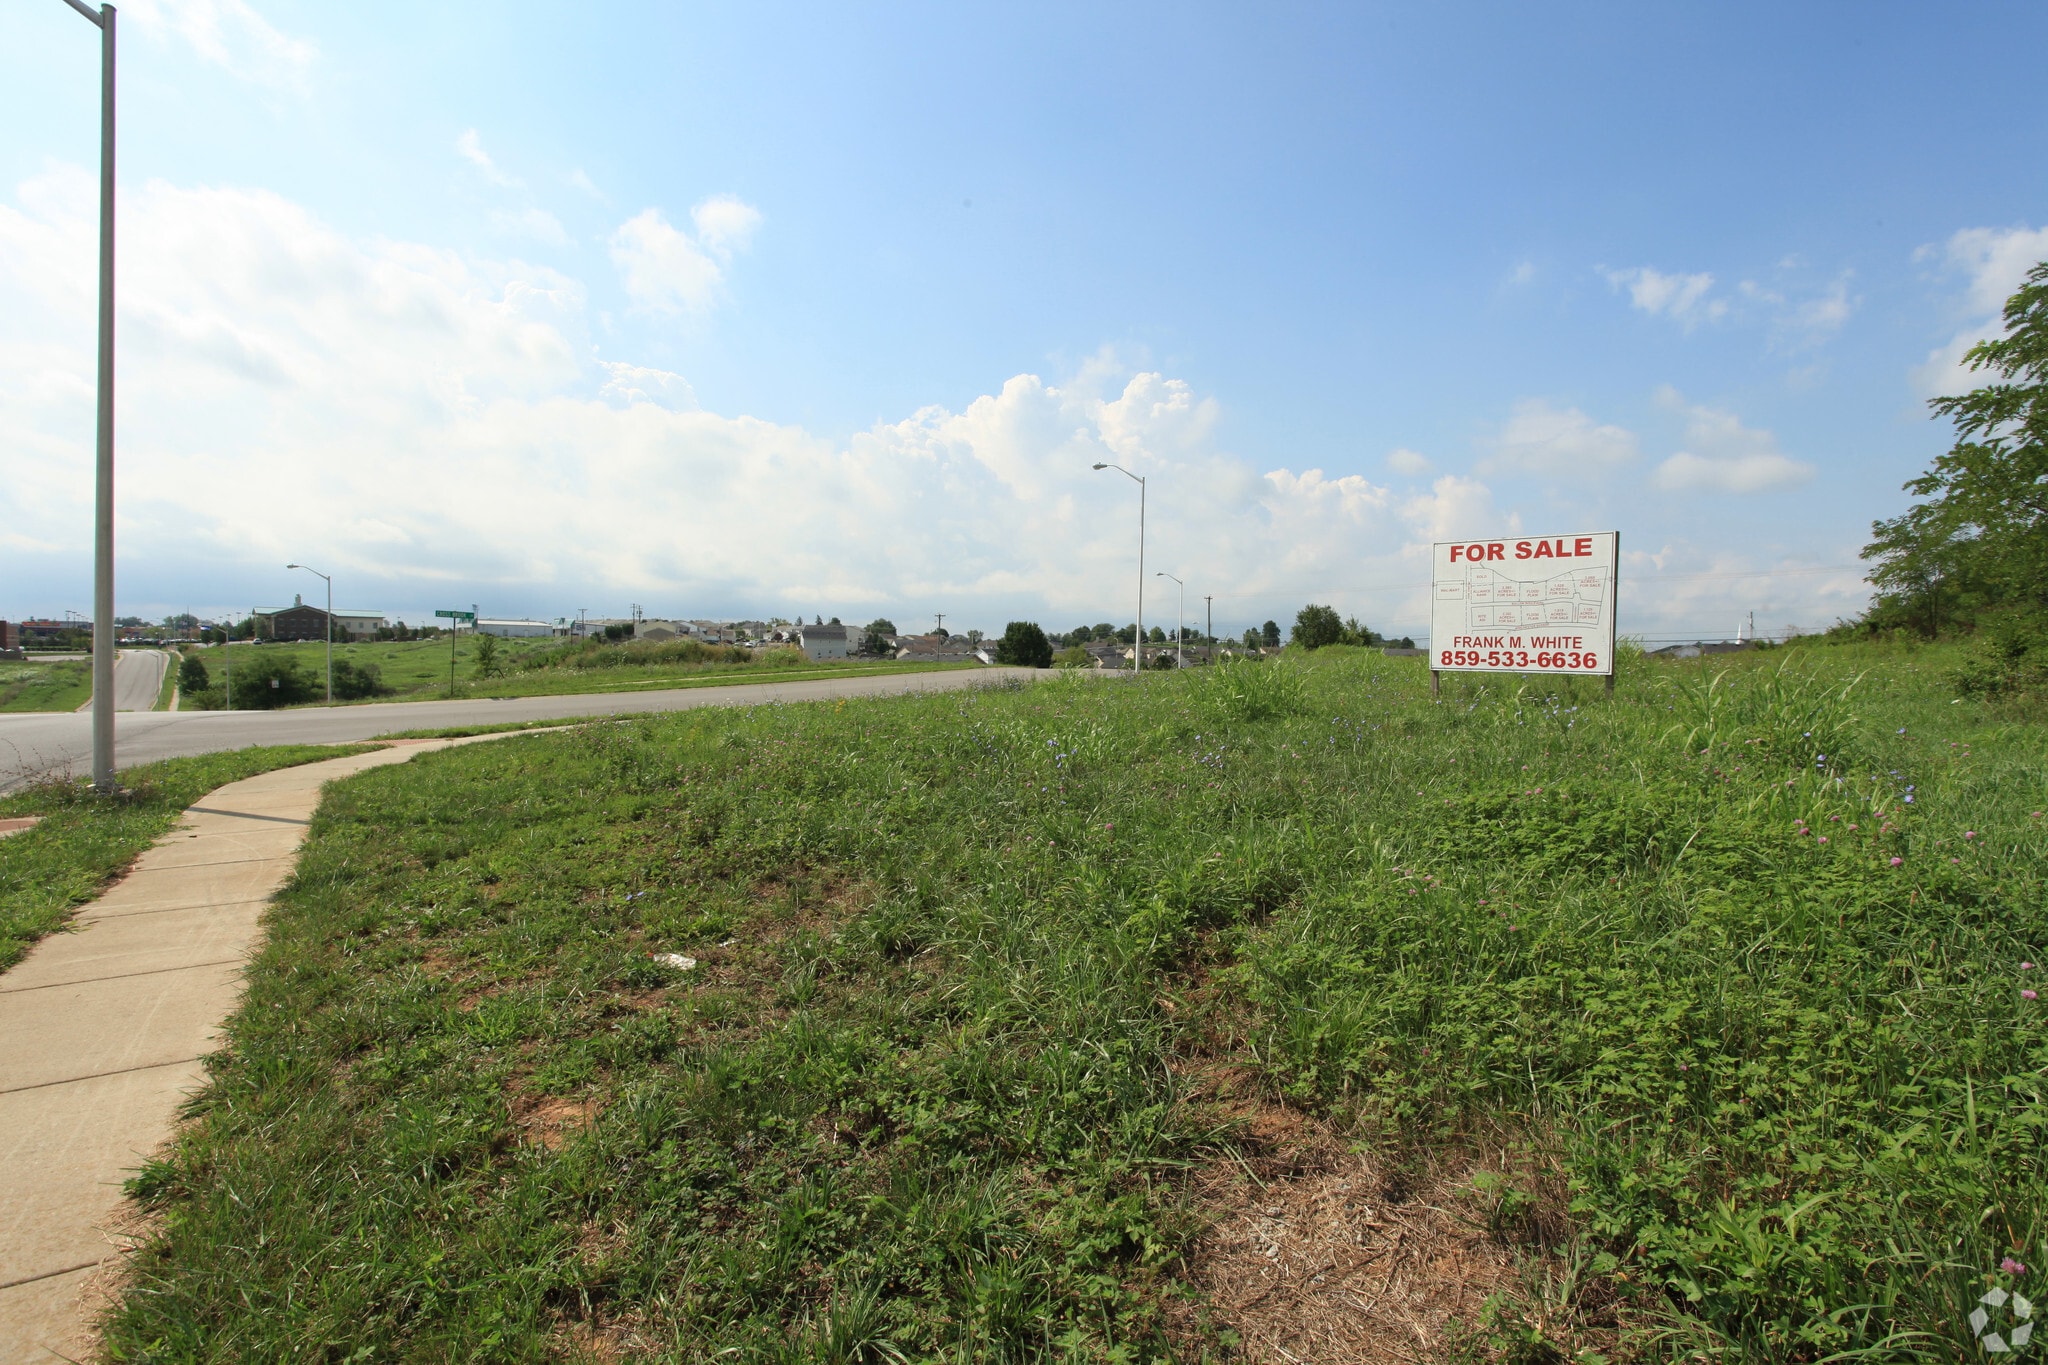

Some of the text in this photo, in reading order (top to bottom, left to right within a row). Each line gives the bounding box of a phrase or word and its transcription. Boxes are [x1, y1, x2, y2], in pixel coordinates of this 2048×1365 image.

[1450, 538, 1593, 563] FOR SALE
[1453, 636, 1583, 650] FRANK M. WHITE
[1440, 650, 1598, 669] 859-533-6636
